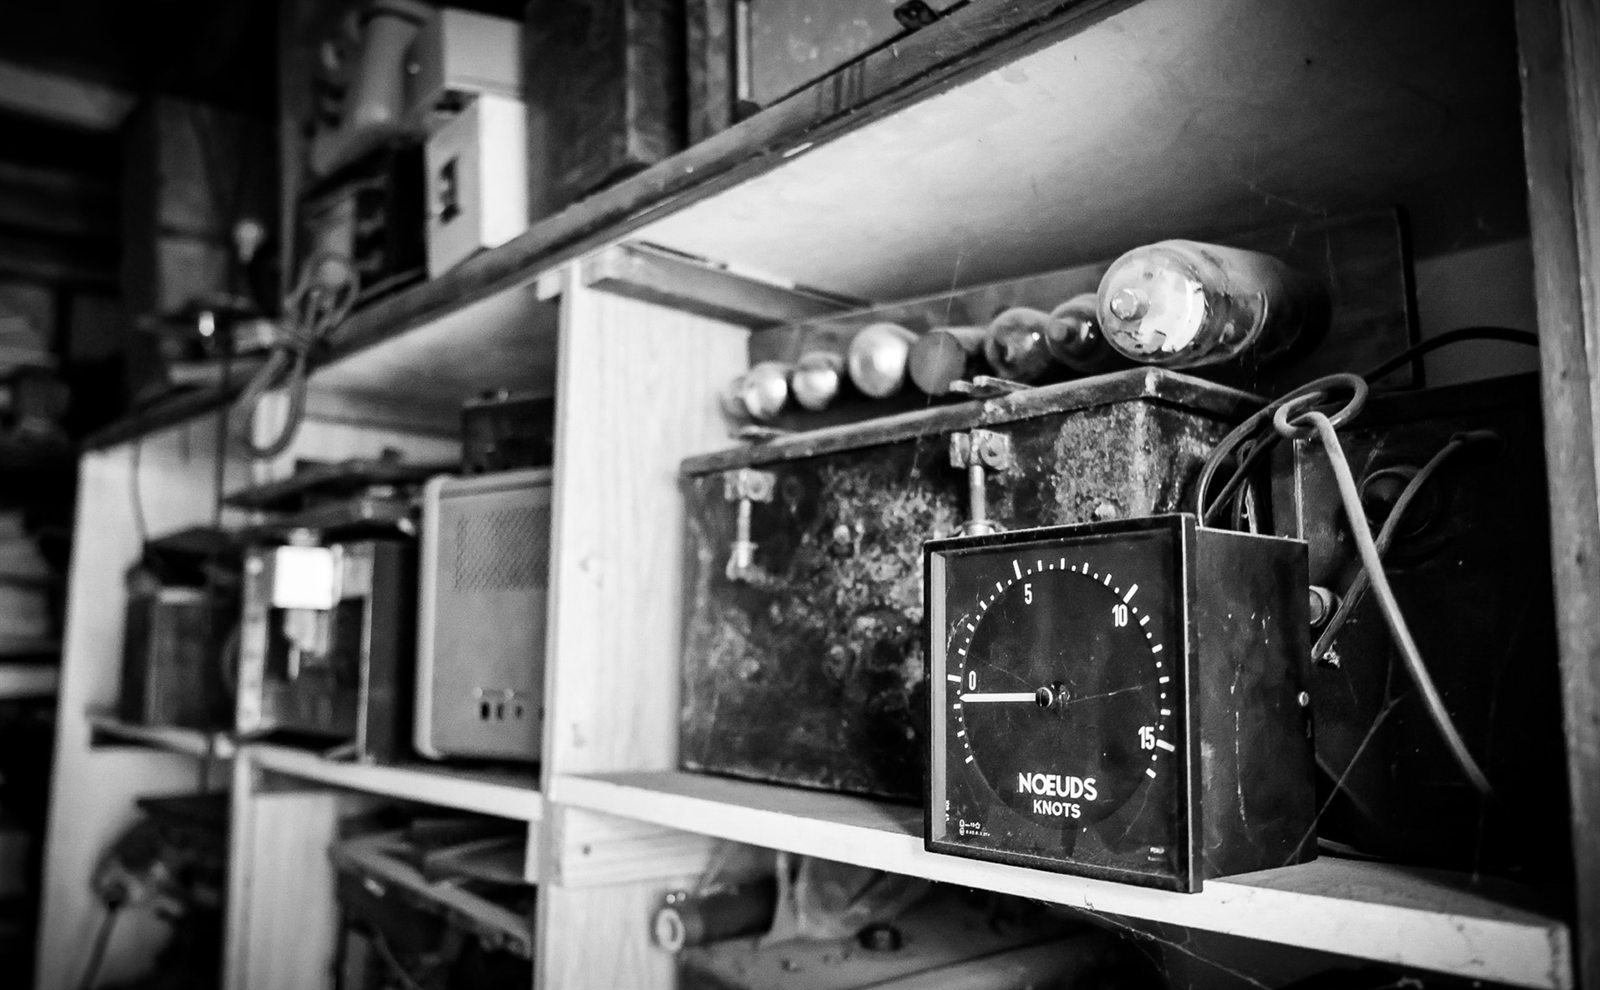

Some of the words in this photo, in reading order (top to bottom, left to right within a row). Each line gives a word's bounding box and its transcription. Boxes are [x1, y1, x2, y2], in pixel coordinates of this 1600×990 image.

[1024, 582, 1033, 605] 5
[1111, 603, 1129, 628] 10
[968, 670, 977, 692] 0
[1138, 725, 1156, 751] 15
[1032, 799, 1082, 819] KNOTS
